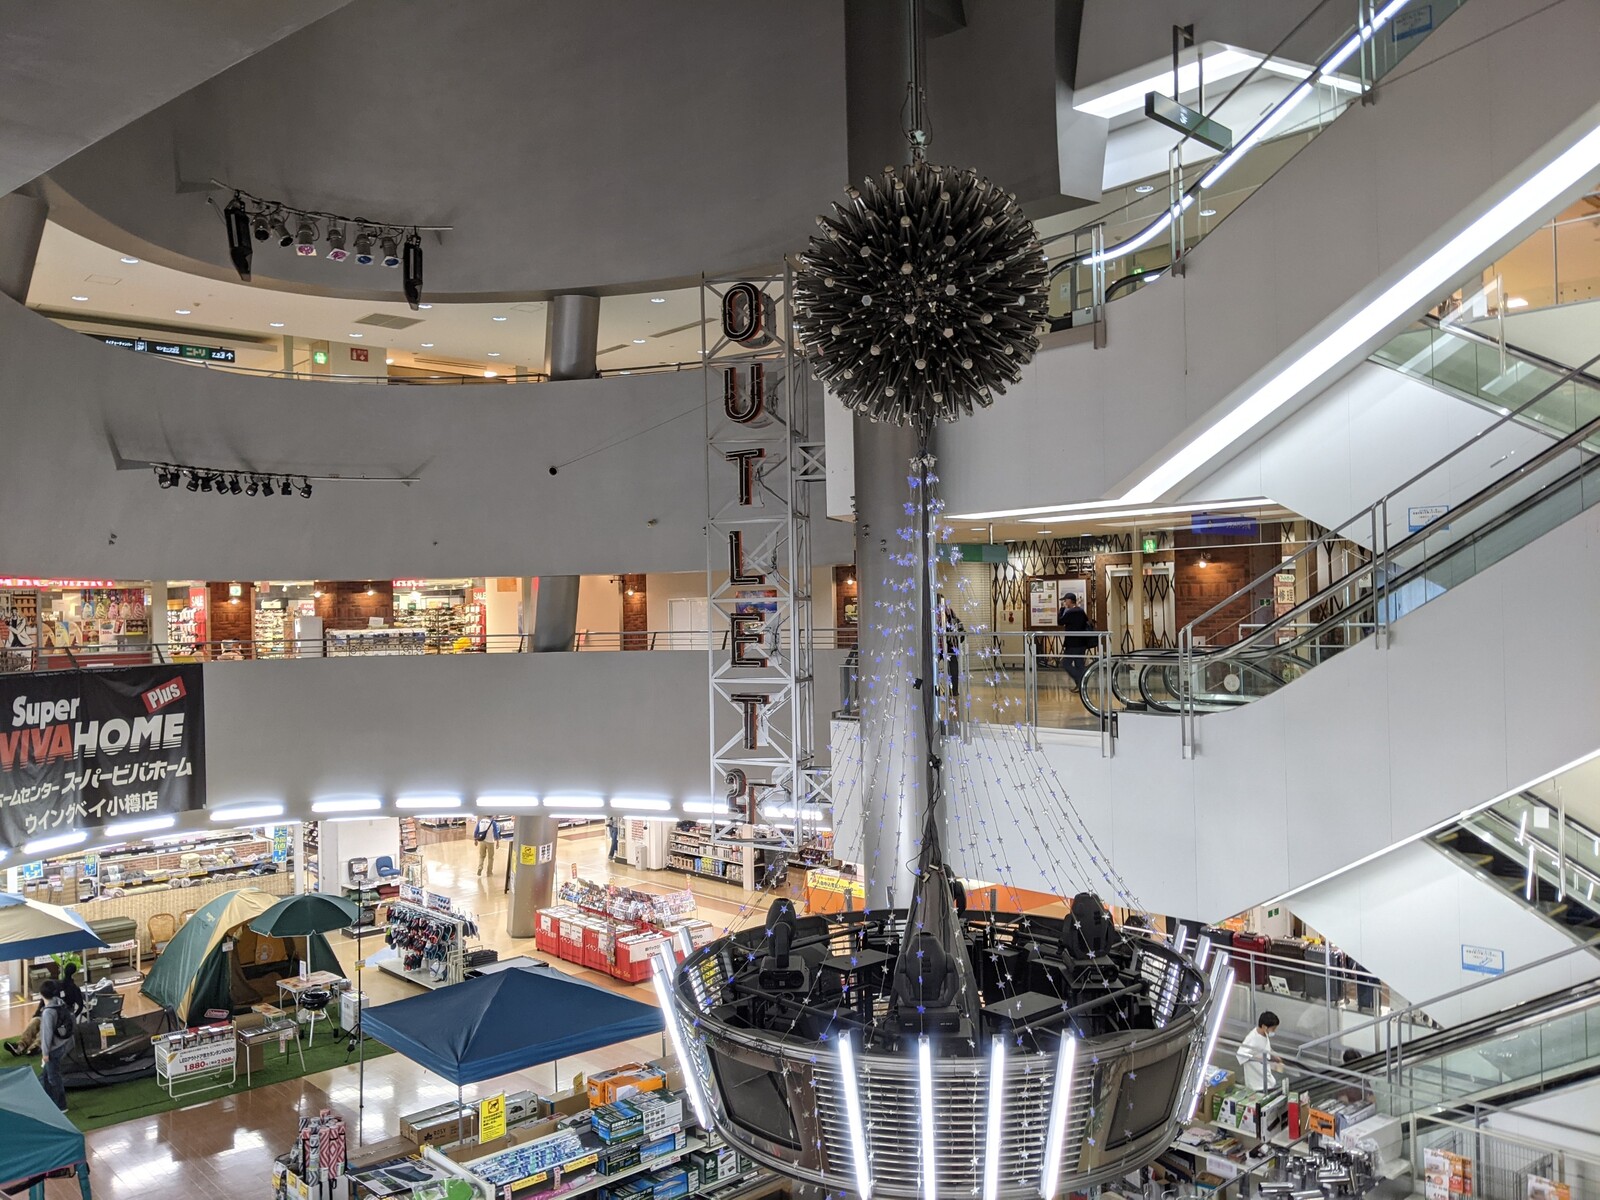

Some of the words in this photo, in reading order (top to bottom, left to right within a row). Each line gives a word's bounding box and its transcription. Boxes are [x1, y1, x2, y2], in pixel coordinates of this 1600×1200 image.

[185, 347, 207, 357] ニトリ
[721, 280, 771, 751] OUTLET
[191, 595, 204, 607] SALE
[12, 695, 80, 729] Super
[147, 682, 181, 710] Plus
[61, 756, 193, 795] スーパービバホーム
[25, 790, 159, 834] ウイングベイ小樽店
